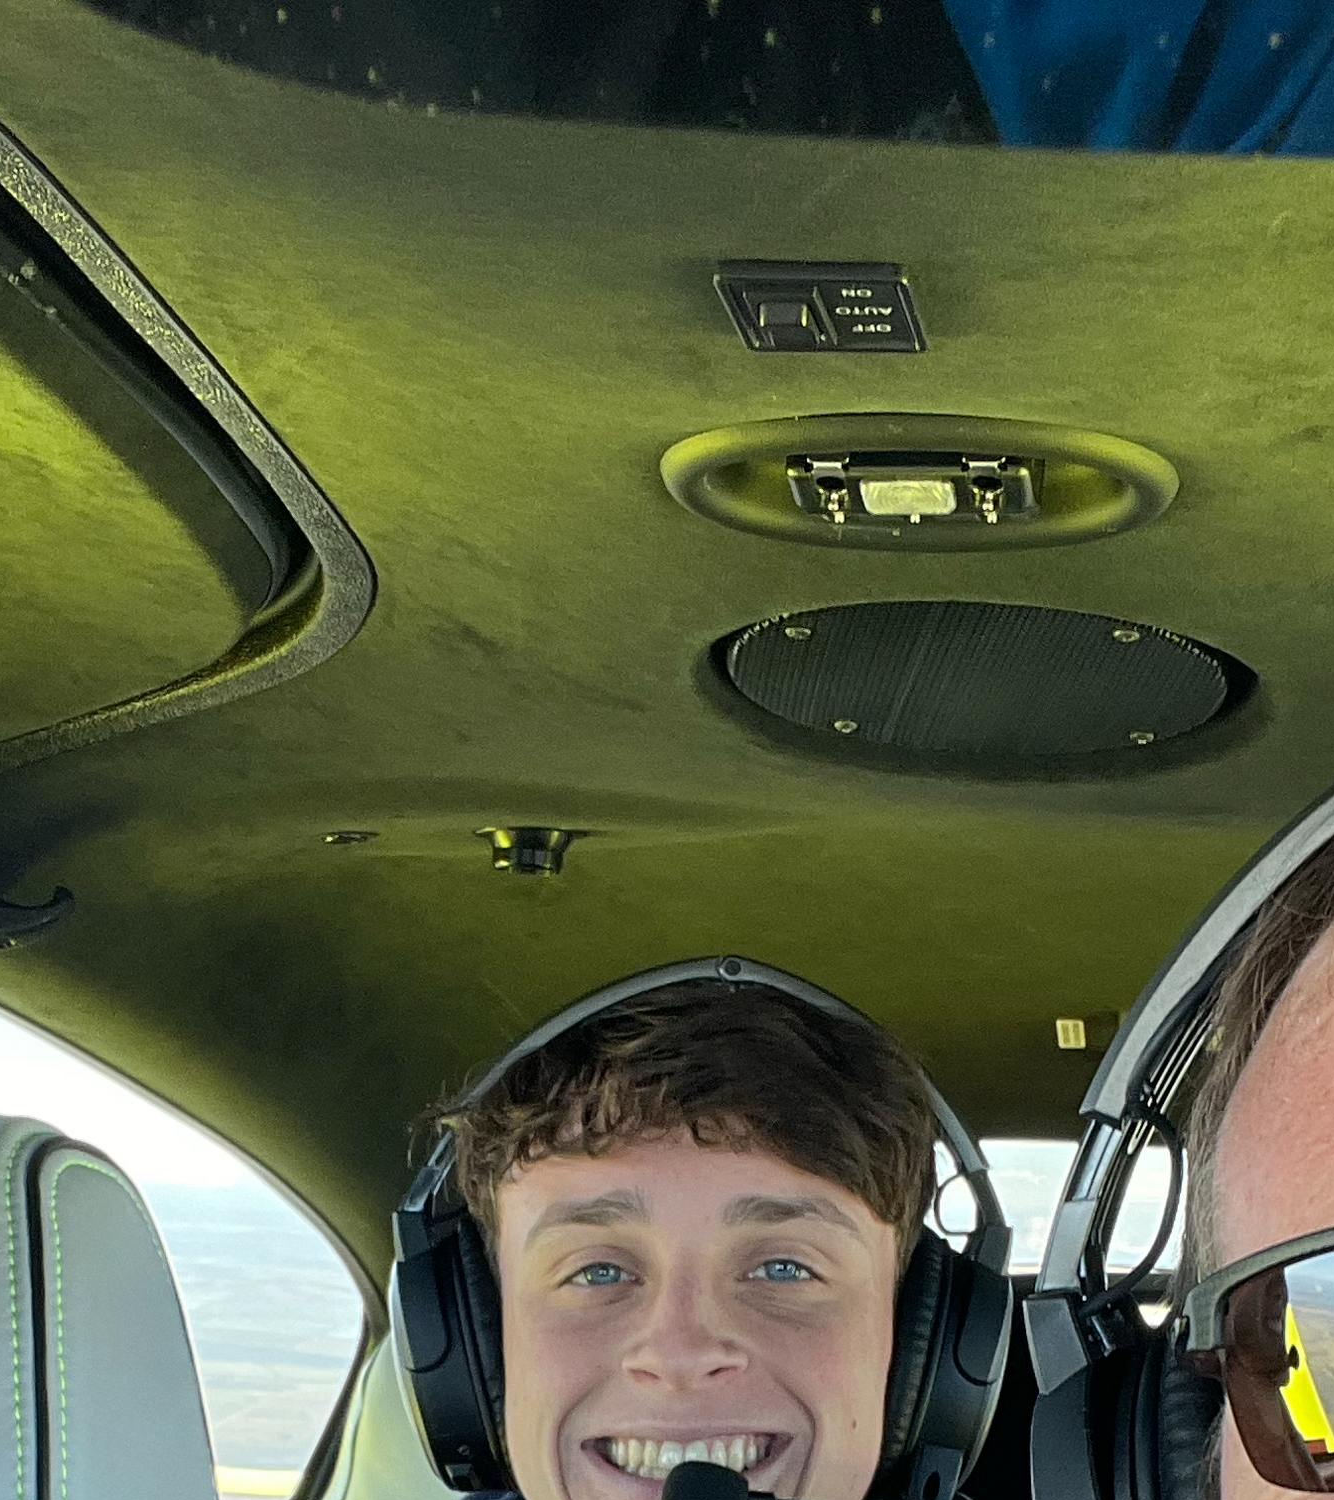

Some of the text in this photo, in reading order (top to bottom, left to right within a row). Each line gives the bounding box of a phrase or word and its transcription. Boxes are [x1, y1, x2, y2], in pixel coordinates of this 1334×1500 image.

[841, 287, 873, 298] ON
[835, 305, 893, 317] AUTO
[851, 323, 892, 334] OFF
